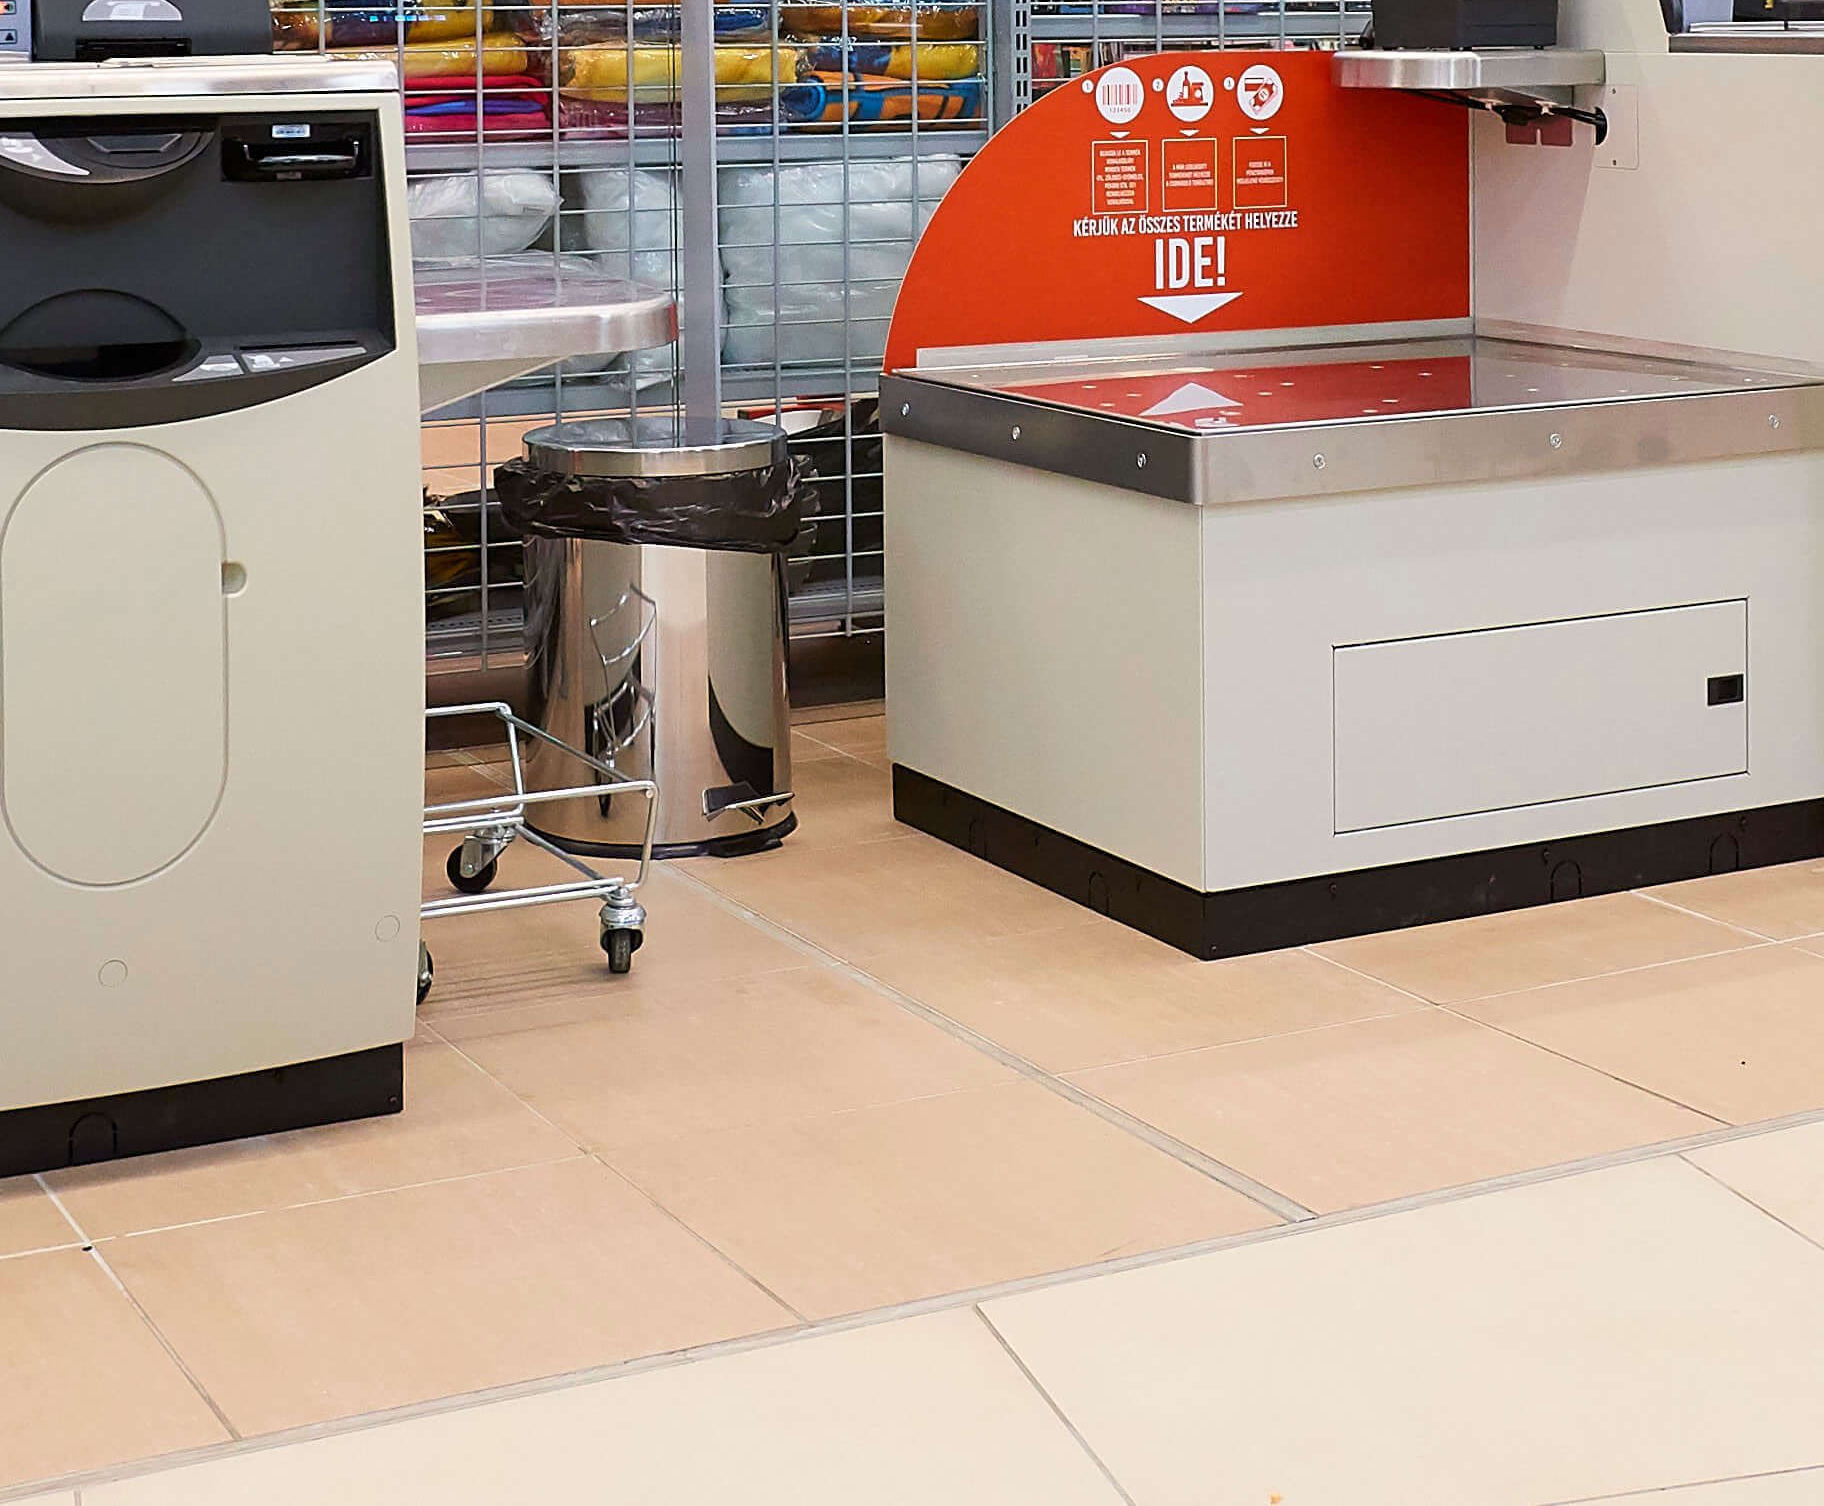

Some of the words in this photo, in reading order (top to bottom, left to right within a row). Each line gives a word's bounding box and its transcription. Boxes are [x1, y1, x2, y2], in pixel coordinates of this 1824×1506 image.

[1073, 216, 1119, 237] KÉRJÜK
[1121, 216, 1136, 234] AZ
[1138, 212, 1180, 233] ÖSSZES
[1183, 211, 1243, 231] TERMÉKÉT
[1244, 210, 1298, 229] HELYEZZE
[1154, 236, 1227, 290] IDE!
